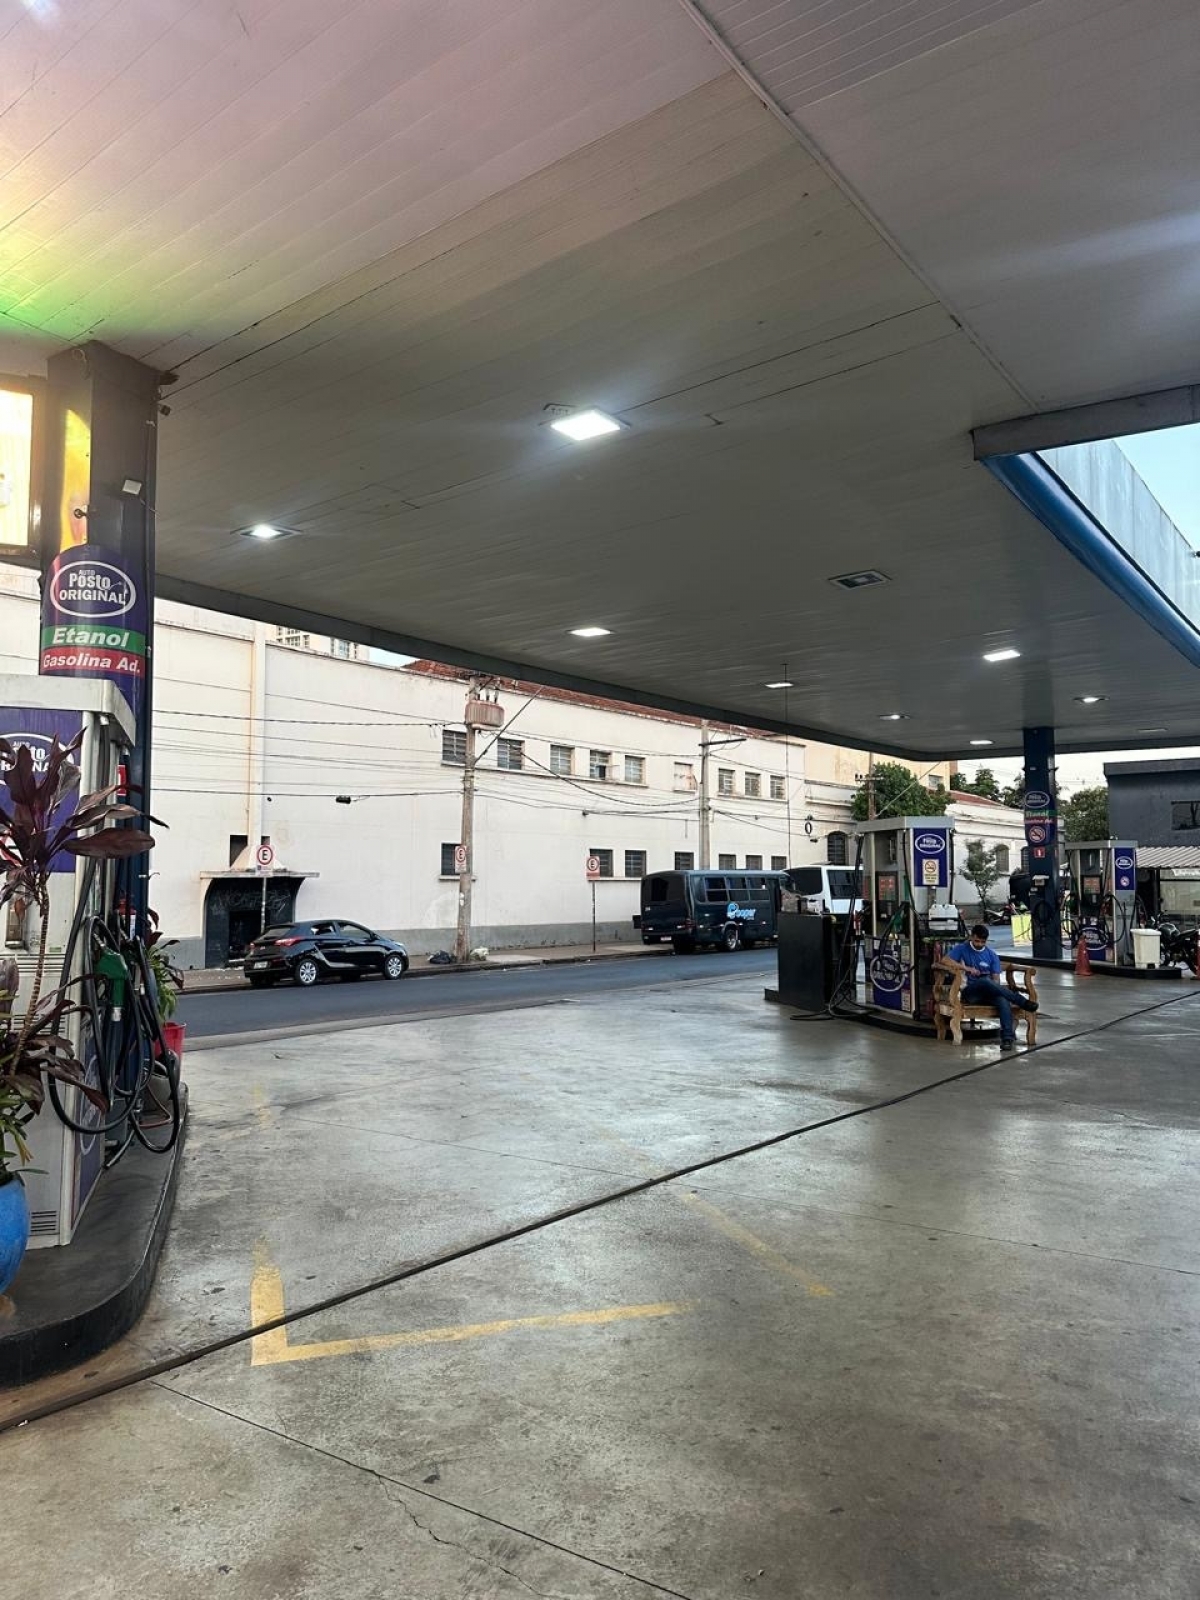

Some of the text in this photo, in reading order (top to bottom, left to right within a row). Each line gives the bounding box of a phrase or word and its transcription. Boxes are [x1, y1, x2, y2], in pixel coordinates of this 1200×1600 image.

[69, 573, 111, 589] Posto
[59, 589, 126, 605] ORIGINAL
[52, 627, 130, 647] Etanol
[43, 653, 140, 673] Gasolina Ad.
[262, 849, 268, 861] E
